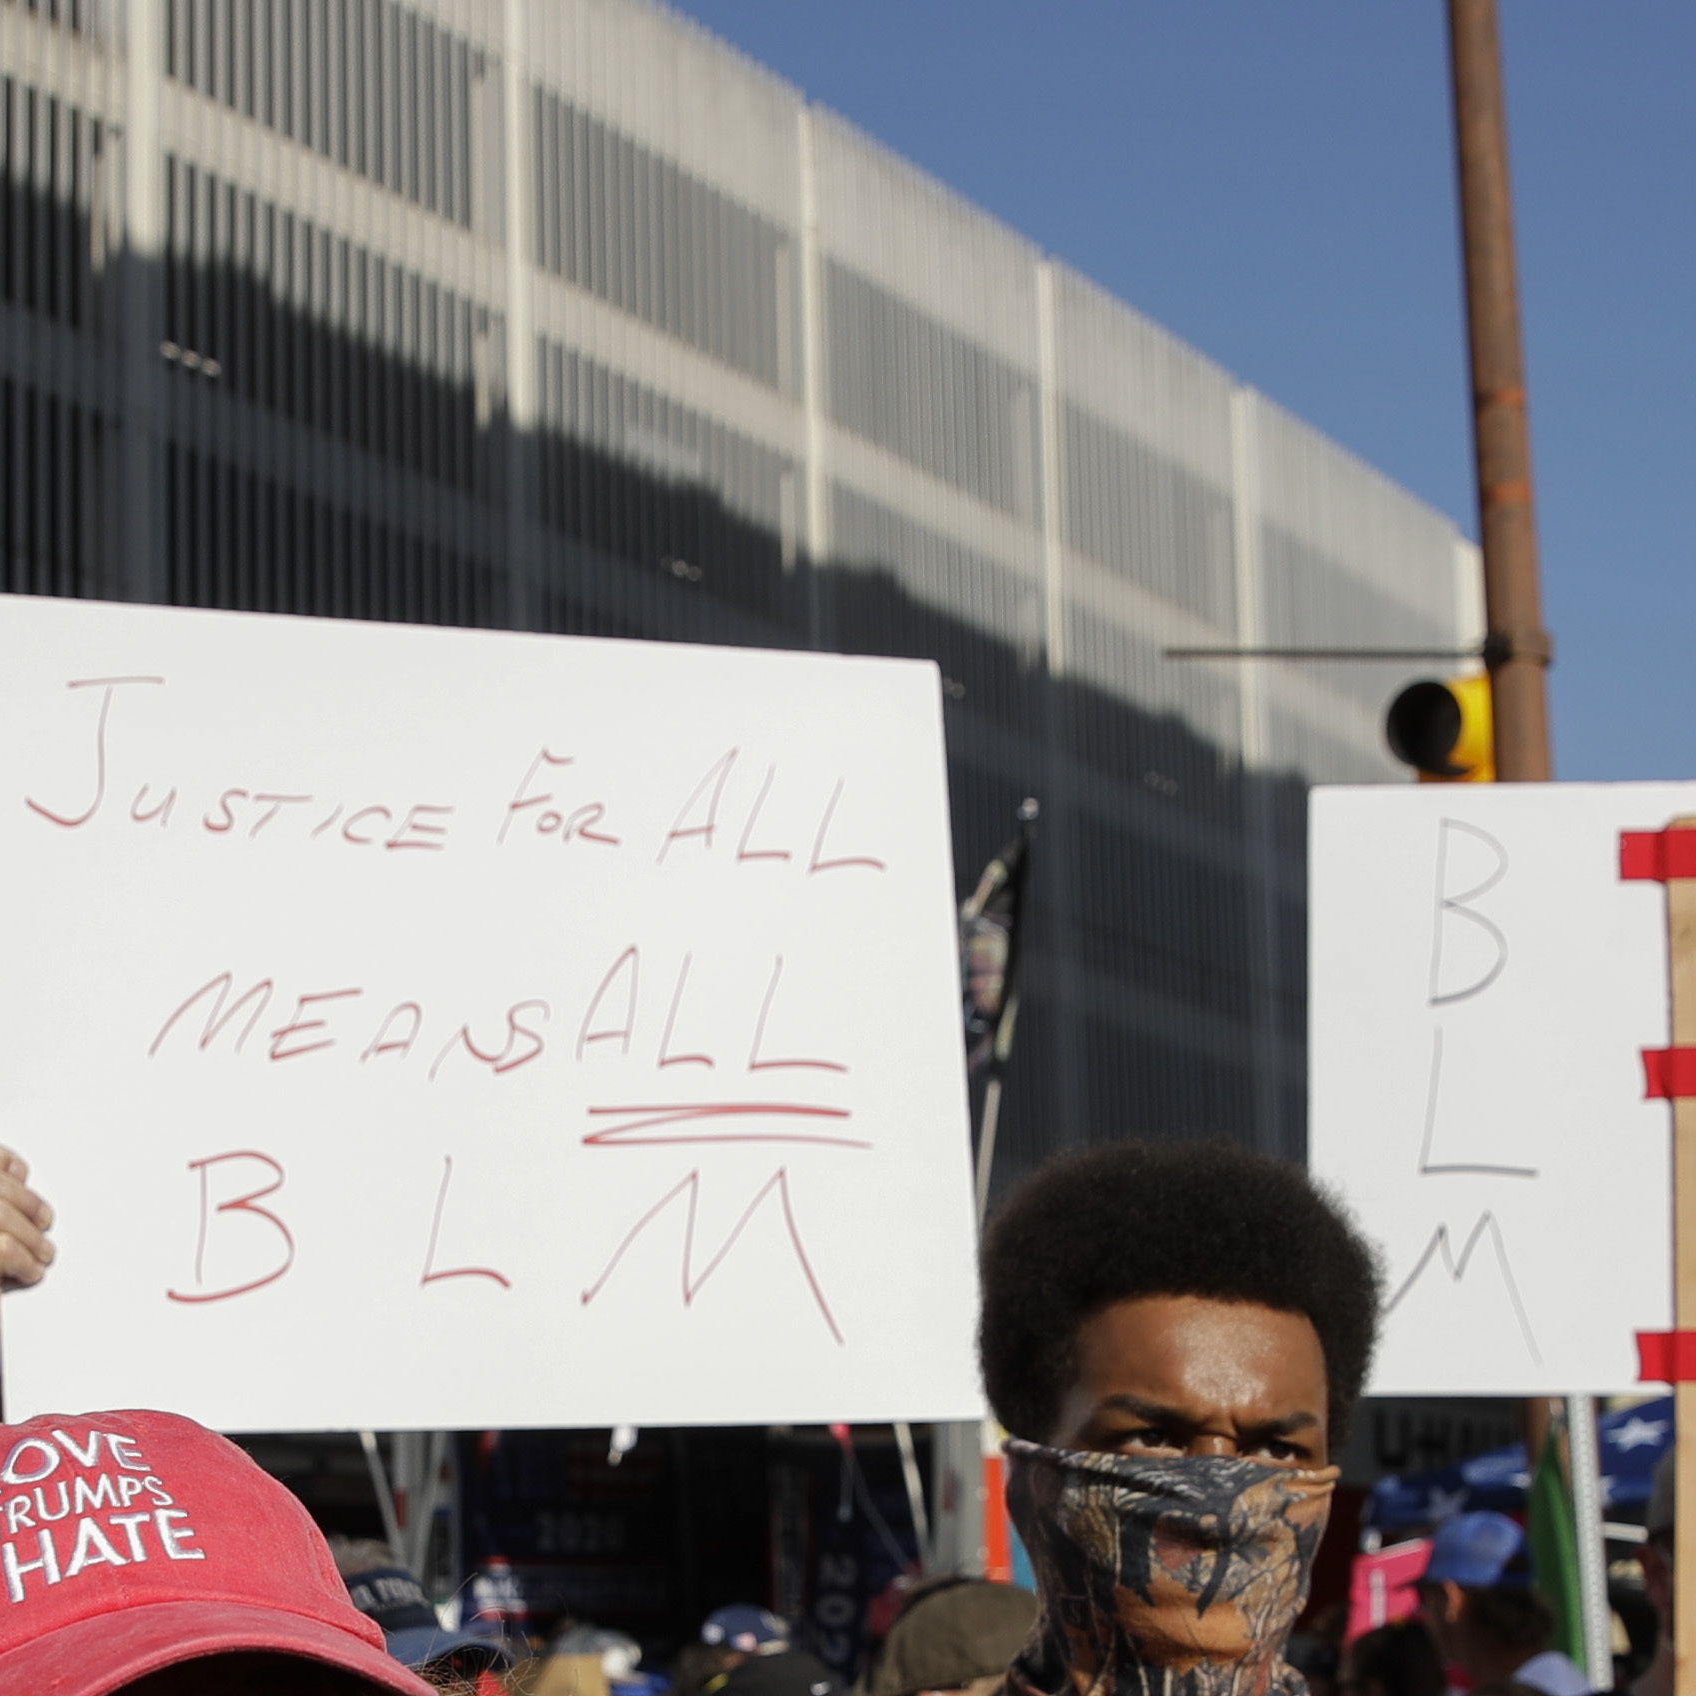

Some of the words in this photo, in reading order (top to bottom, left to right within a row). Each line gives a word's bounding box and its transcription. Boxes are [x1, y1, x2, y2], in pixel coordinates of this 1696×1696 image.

[657, 746, 886, 874] ALL
[149, 970, 551, 1080] MEANS
[576, 945, 849, 1075] ALL
[1, 1507, 205, 1604] HATE
